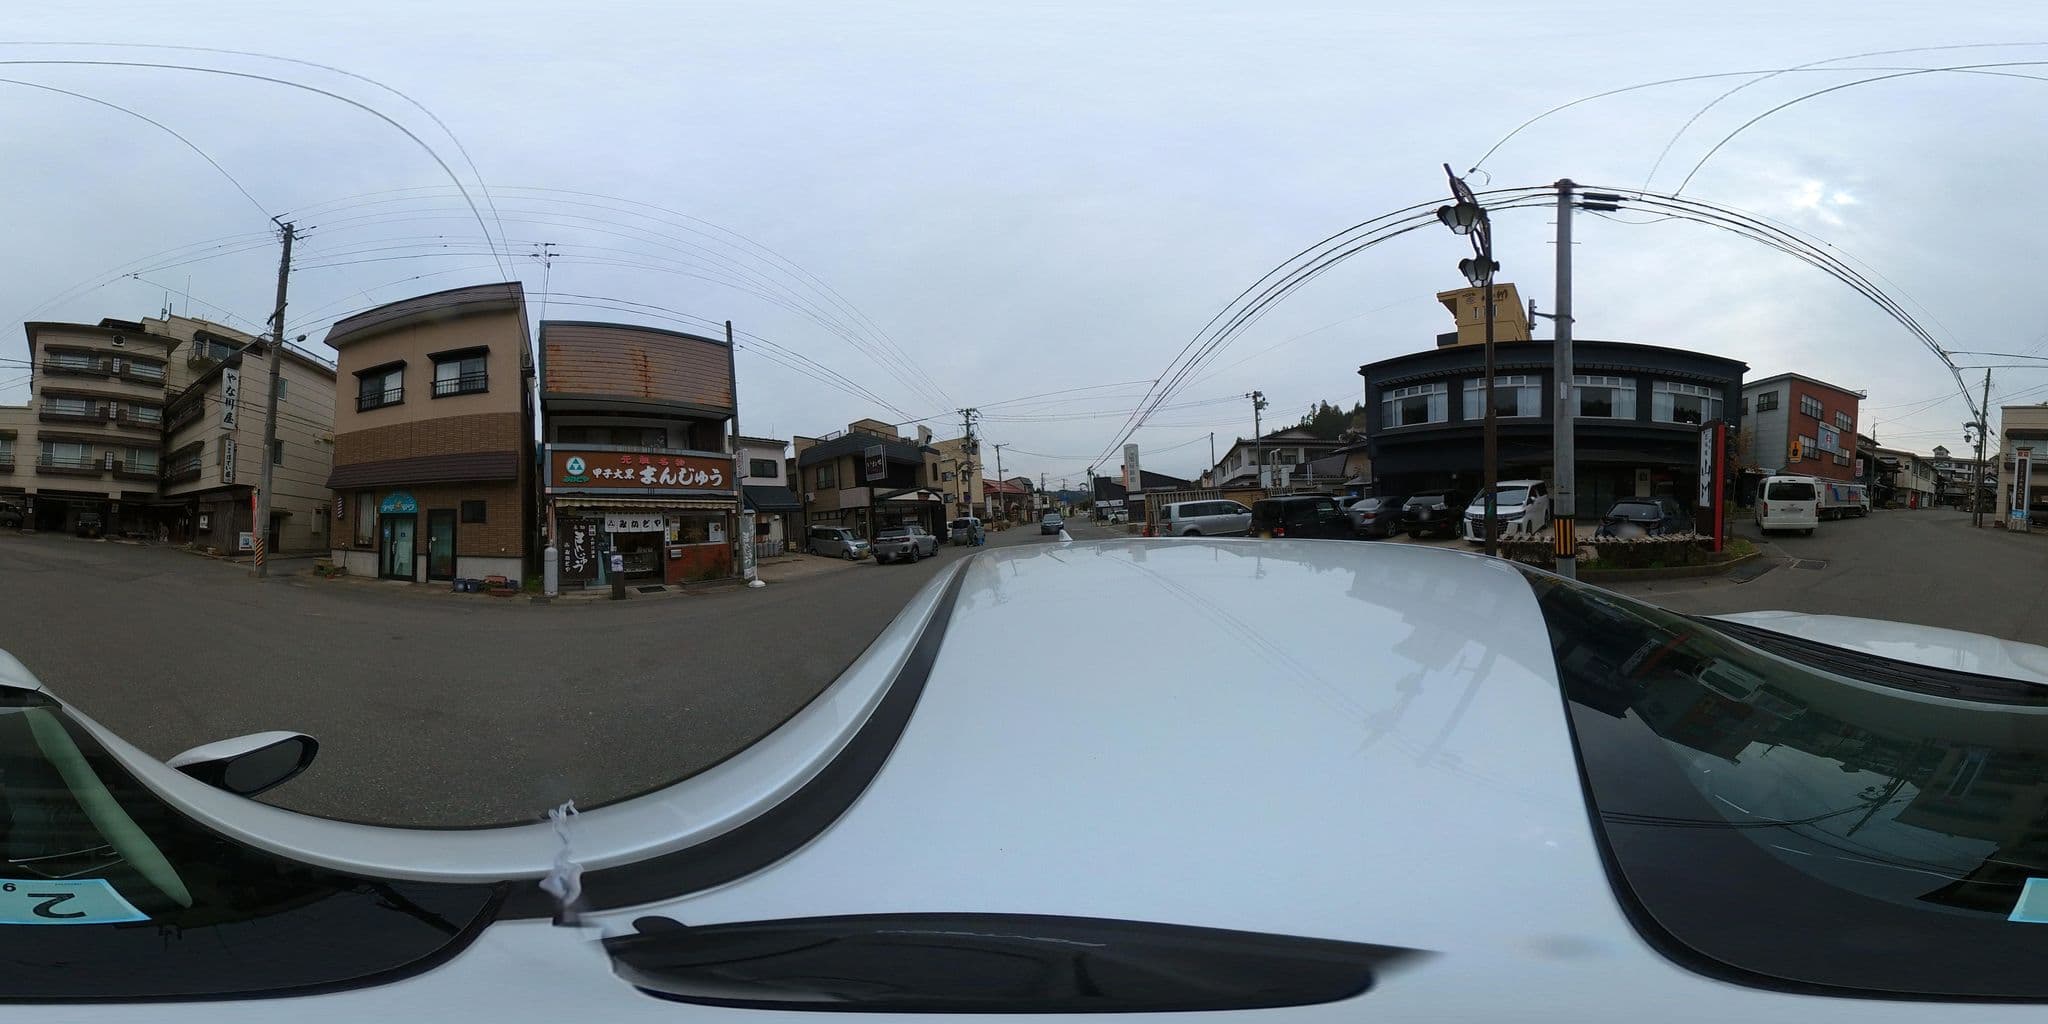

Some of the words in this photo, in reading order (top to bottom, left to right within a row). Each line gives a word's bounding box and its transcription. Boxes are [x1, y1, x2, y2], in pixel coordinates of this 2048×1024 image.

[223, 373, 236, 424] やな川屋
[592, 468, 635, 480] 甲子大黒
[639, 465, 723, 487] まんじゅう
[27, 893, 87, 919] 2
